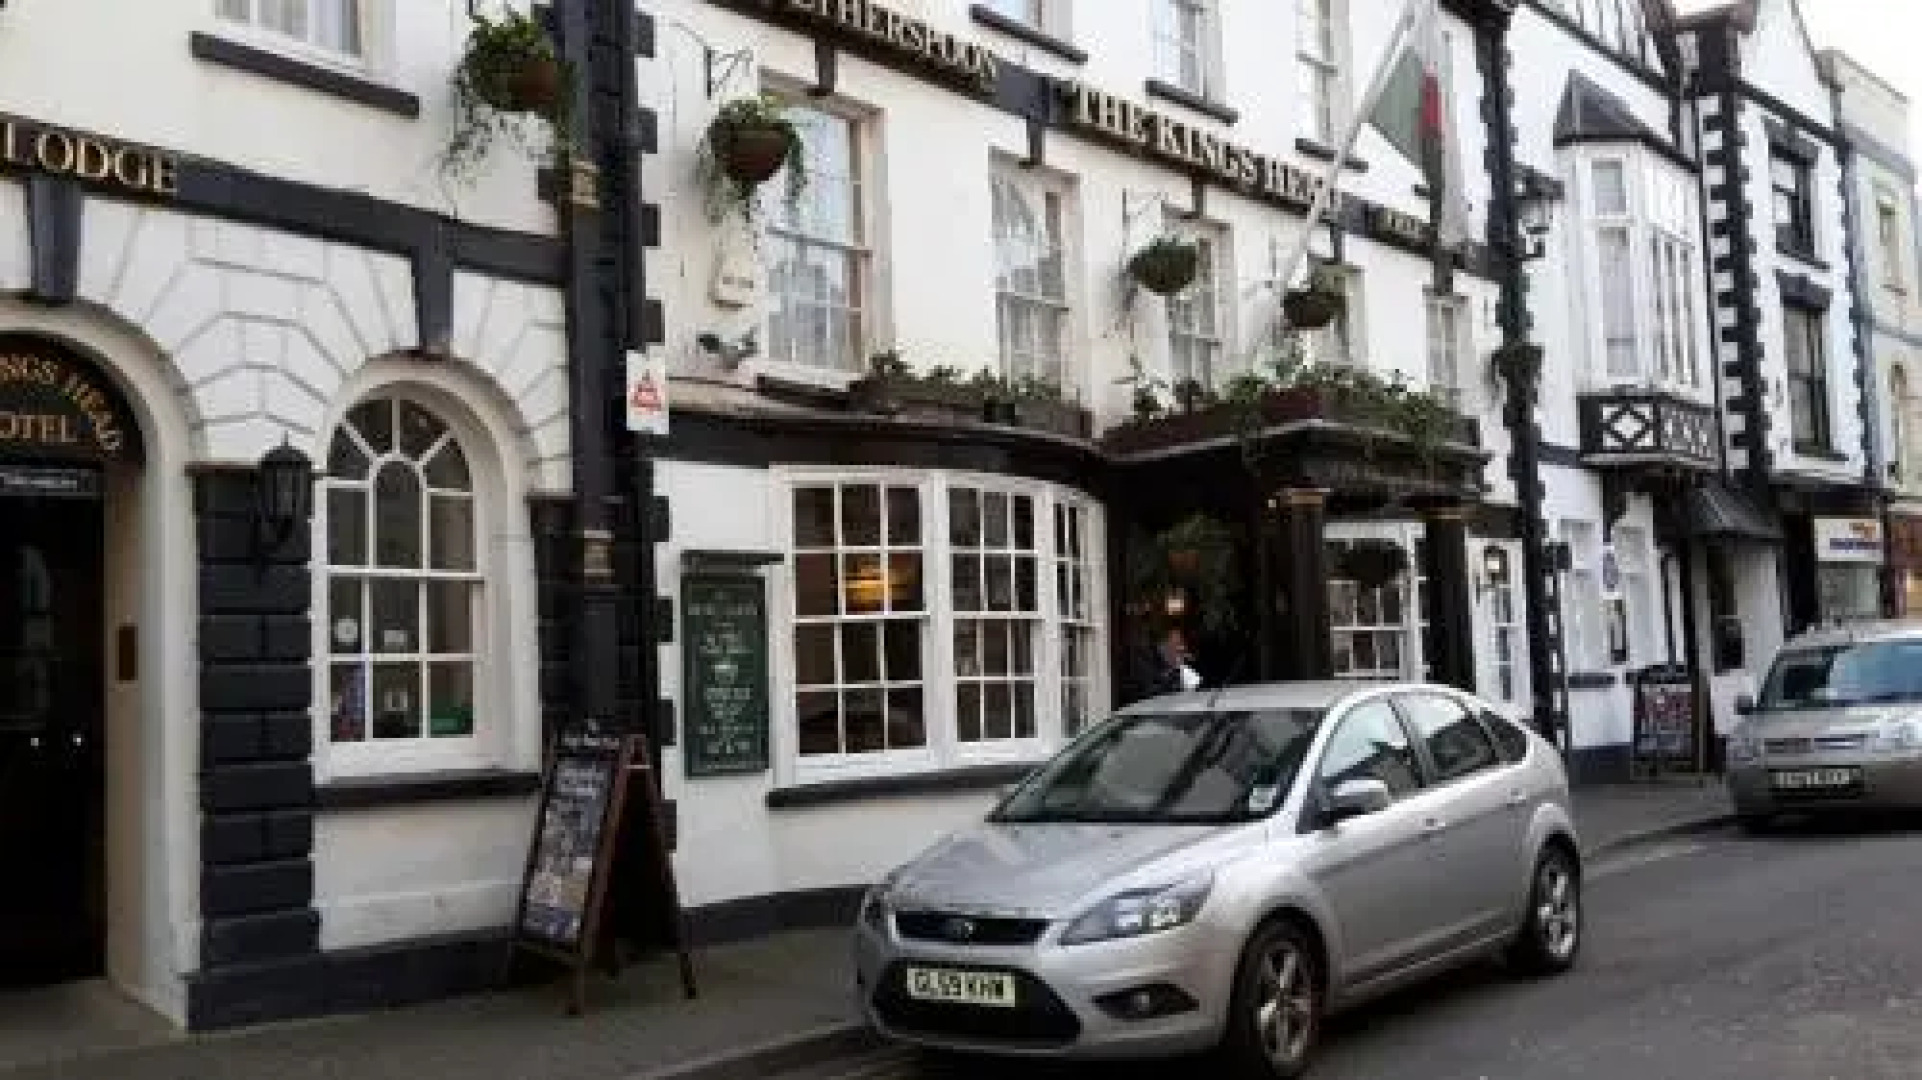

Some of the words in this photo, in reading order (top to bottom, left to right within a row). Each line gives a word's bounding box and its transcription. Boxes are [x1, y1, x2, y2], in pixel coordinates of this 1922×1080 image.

[3, 122, 178, 193] LODGE
[1072, 81, 1147, 141] THE
[1156, 113, 1258, 183] KINGS
